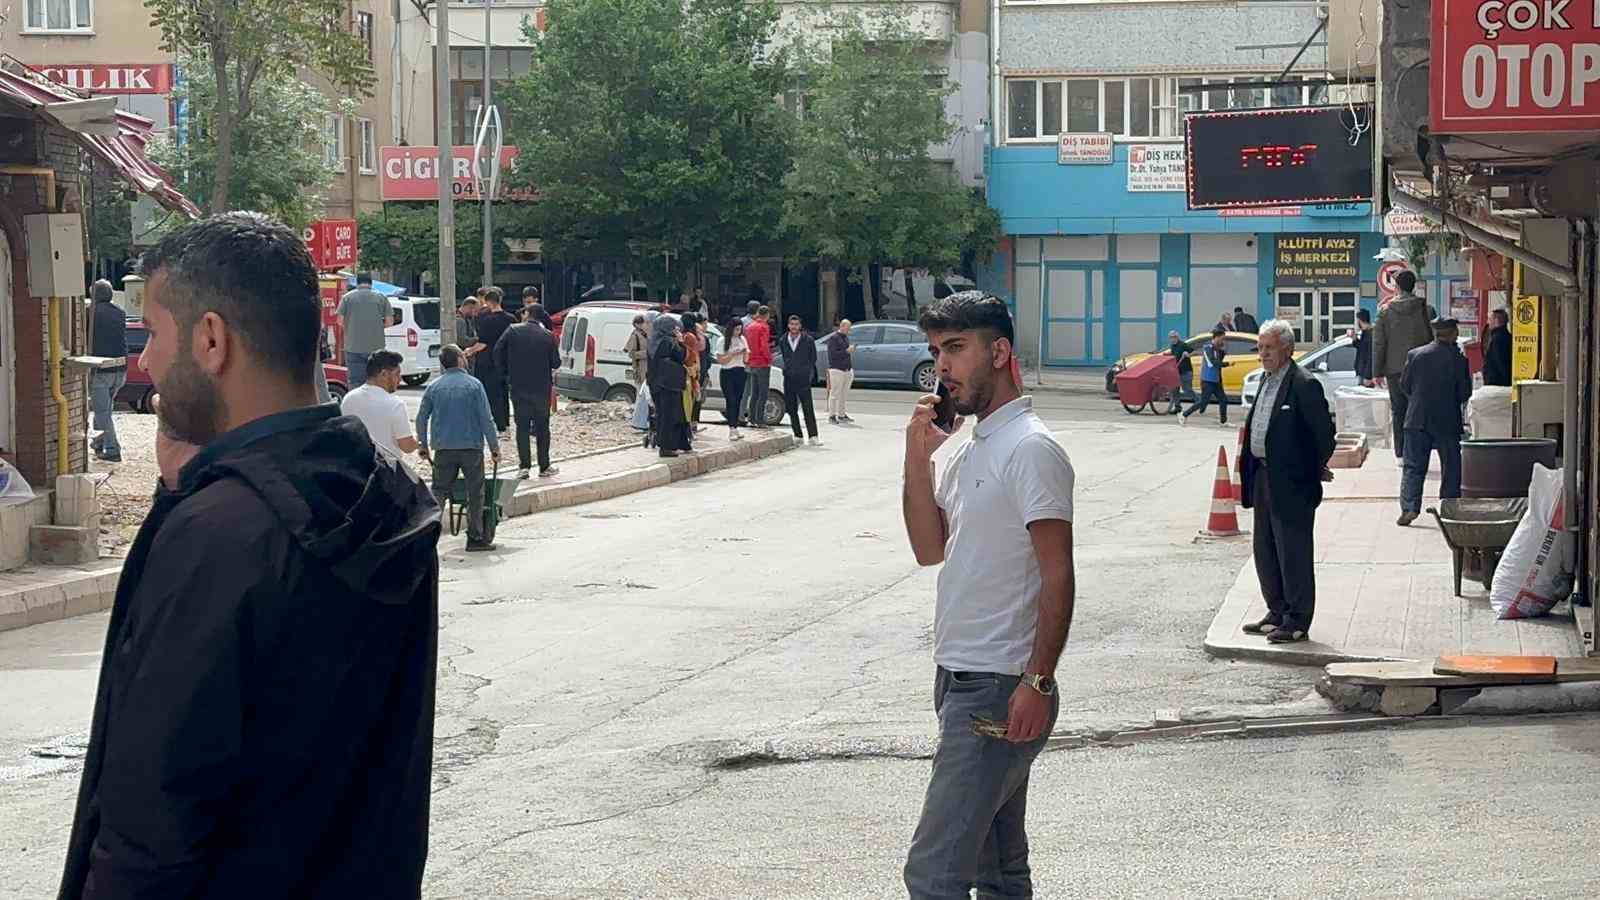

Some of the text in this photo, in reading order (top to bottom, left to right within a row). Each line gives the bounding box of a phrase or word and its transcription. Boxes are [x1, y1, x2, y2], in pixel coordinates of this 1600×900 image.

[1477, 0, 1571, 39] ÇOK
[1462, 42, 1600, 109] OTOP
[1146, 148, 1161, 163] DİŞ
[1278, 237, 1356, 249] H.LÜTFİ AYAZ
[1280, 251, 1350, 264] İŞ MERKEZİ
